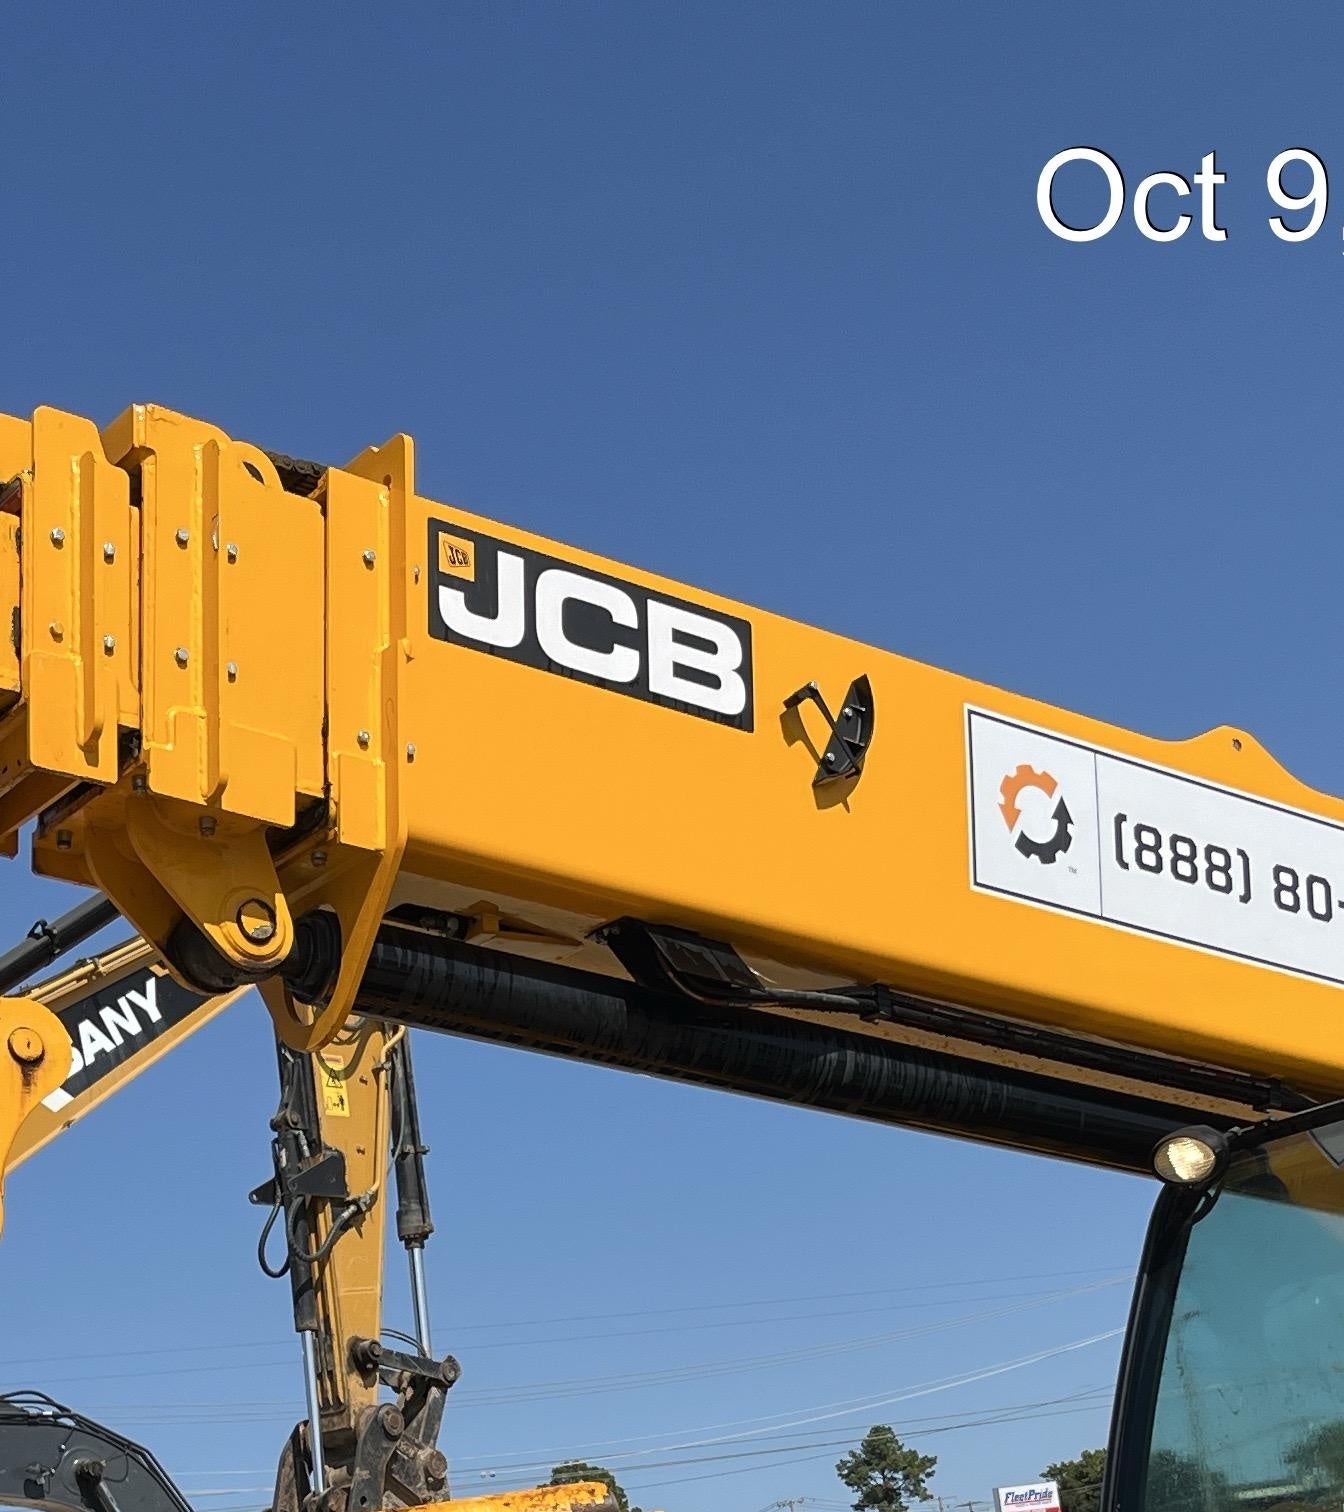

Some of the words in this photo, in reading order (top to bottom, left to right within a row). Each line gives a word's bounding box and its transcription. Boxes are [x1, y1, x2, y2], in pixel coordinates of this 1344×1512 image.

[448, 545, 470, 565] JCB
[438, 550, 746, 715] JCB
[1114, 812, 1252, 904] (888)
[1004, 1488, 1053, 1504] FleetPride
